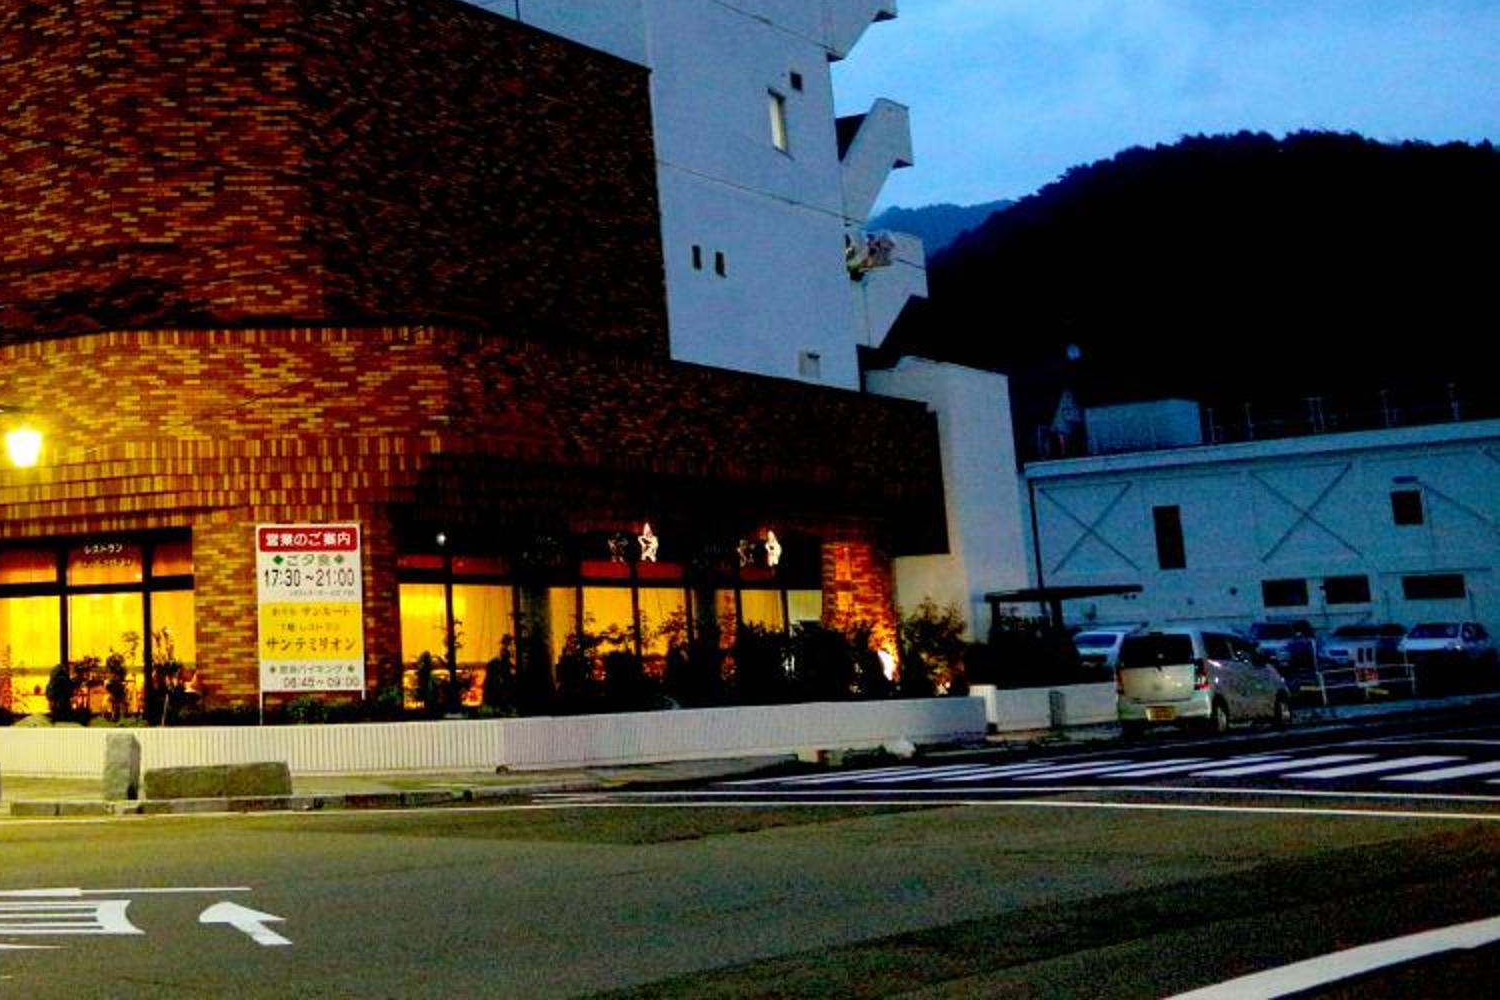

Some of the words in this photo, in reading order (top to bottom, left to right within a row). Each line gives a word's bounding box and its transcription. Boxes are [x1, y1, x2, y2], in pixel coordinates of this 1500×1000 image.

[265, 532, 351, 547] 営業のご案内
